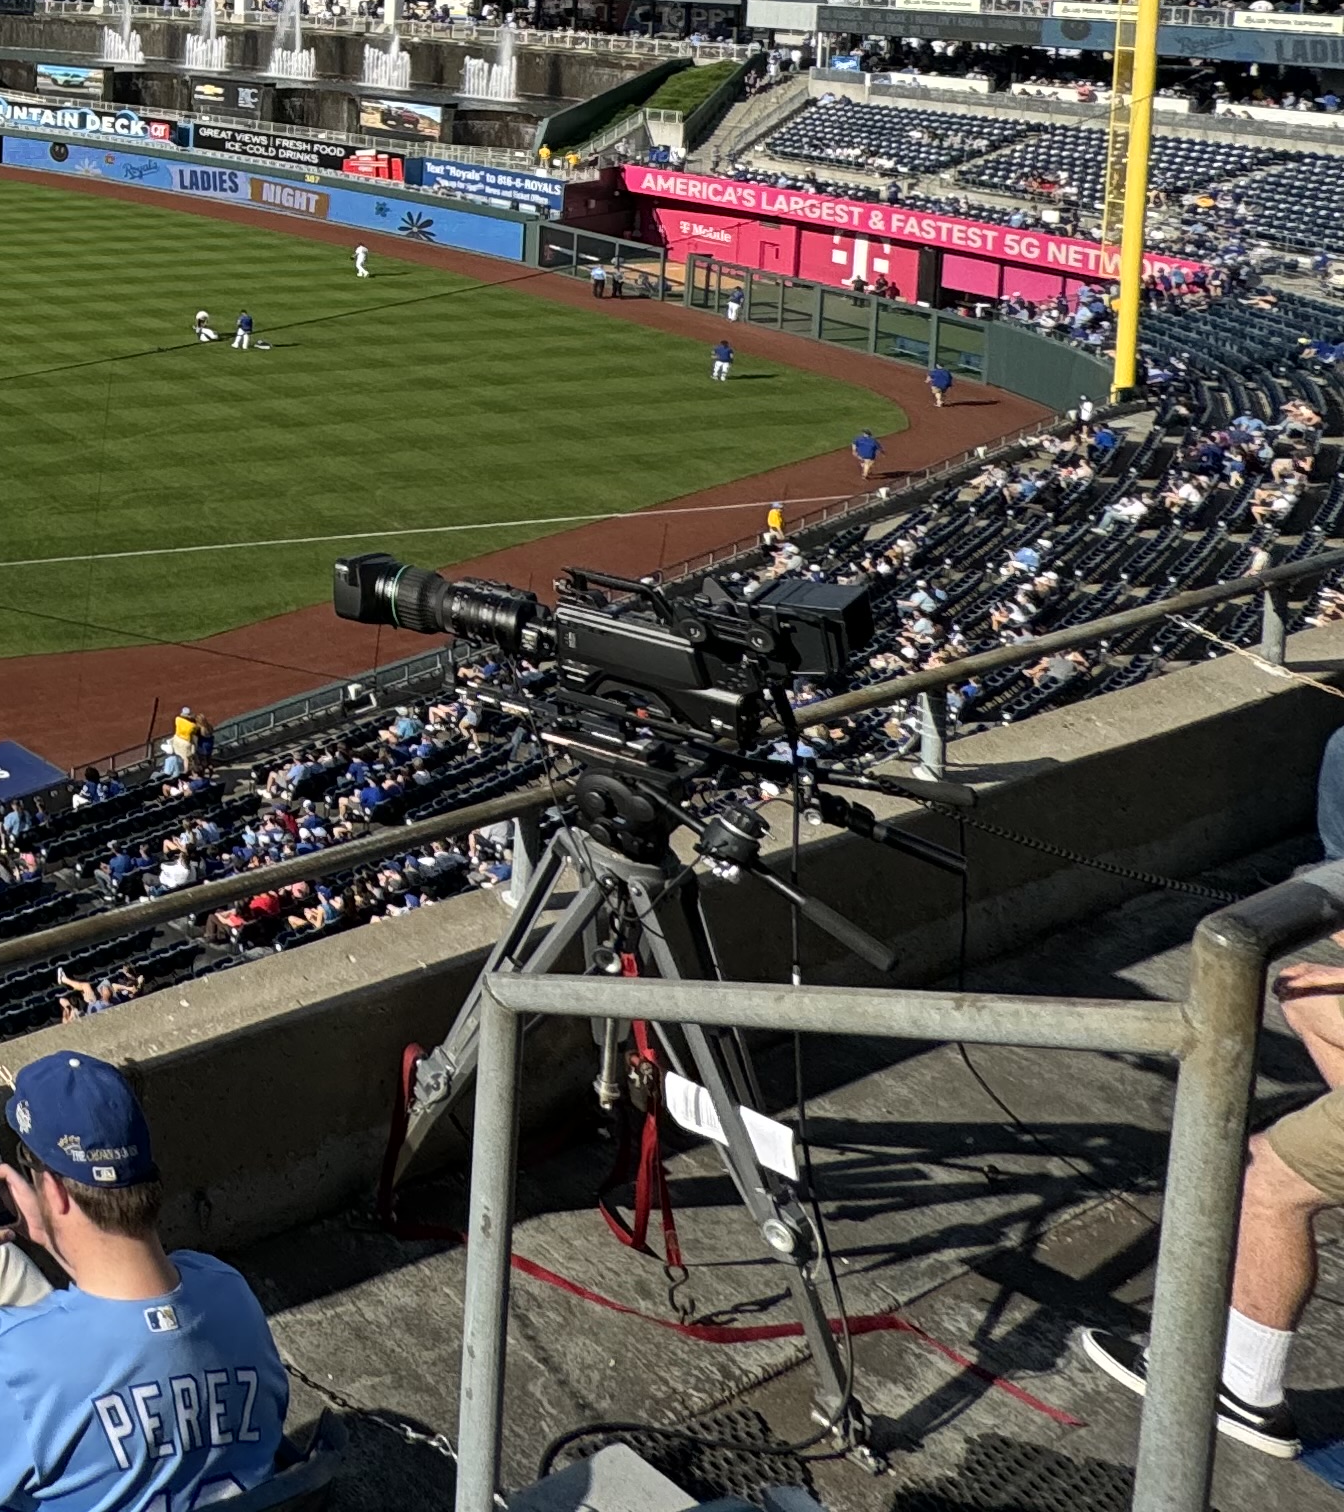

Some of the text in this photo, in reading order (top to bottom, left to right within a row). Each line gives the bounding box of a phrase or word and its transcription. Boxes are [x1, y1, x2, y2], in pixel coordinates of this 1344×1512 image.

[86, 114, 145, 137] DECK
[198, 127, 345, 157] GREAT VIEWS FRESH FOOD
[225, 140, 319, 164] ICE-COLD DRINKS
[122, 159, 320, 213] Royals LADIES NIGHT
[426, 162, 445, 175] Text
[486, 173, 496, 184] to
[641, 172, 757, 208] AMERICA'S
[762, 191, 863, 226] LARGEST
[869, 210, 885, 231] &
[891, 212, 998, 251] FASTEST
[1004, 233, 1041, 259] 5G
[691, 222, 732, 243] Mobile
[92, 1366, 261, 1472] PEREZ
